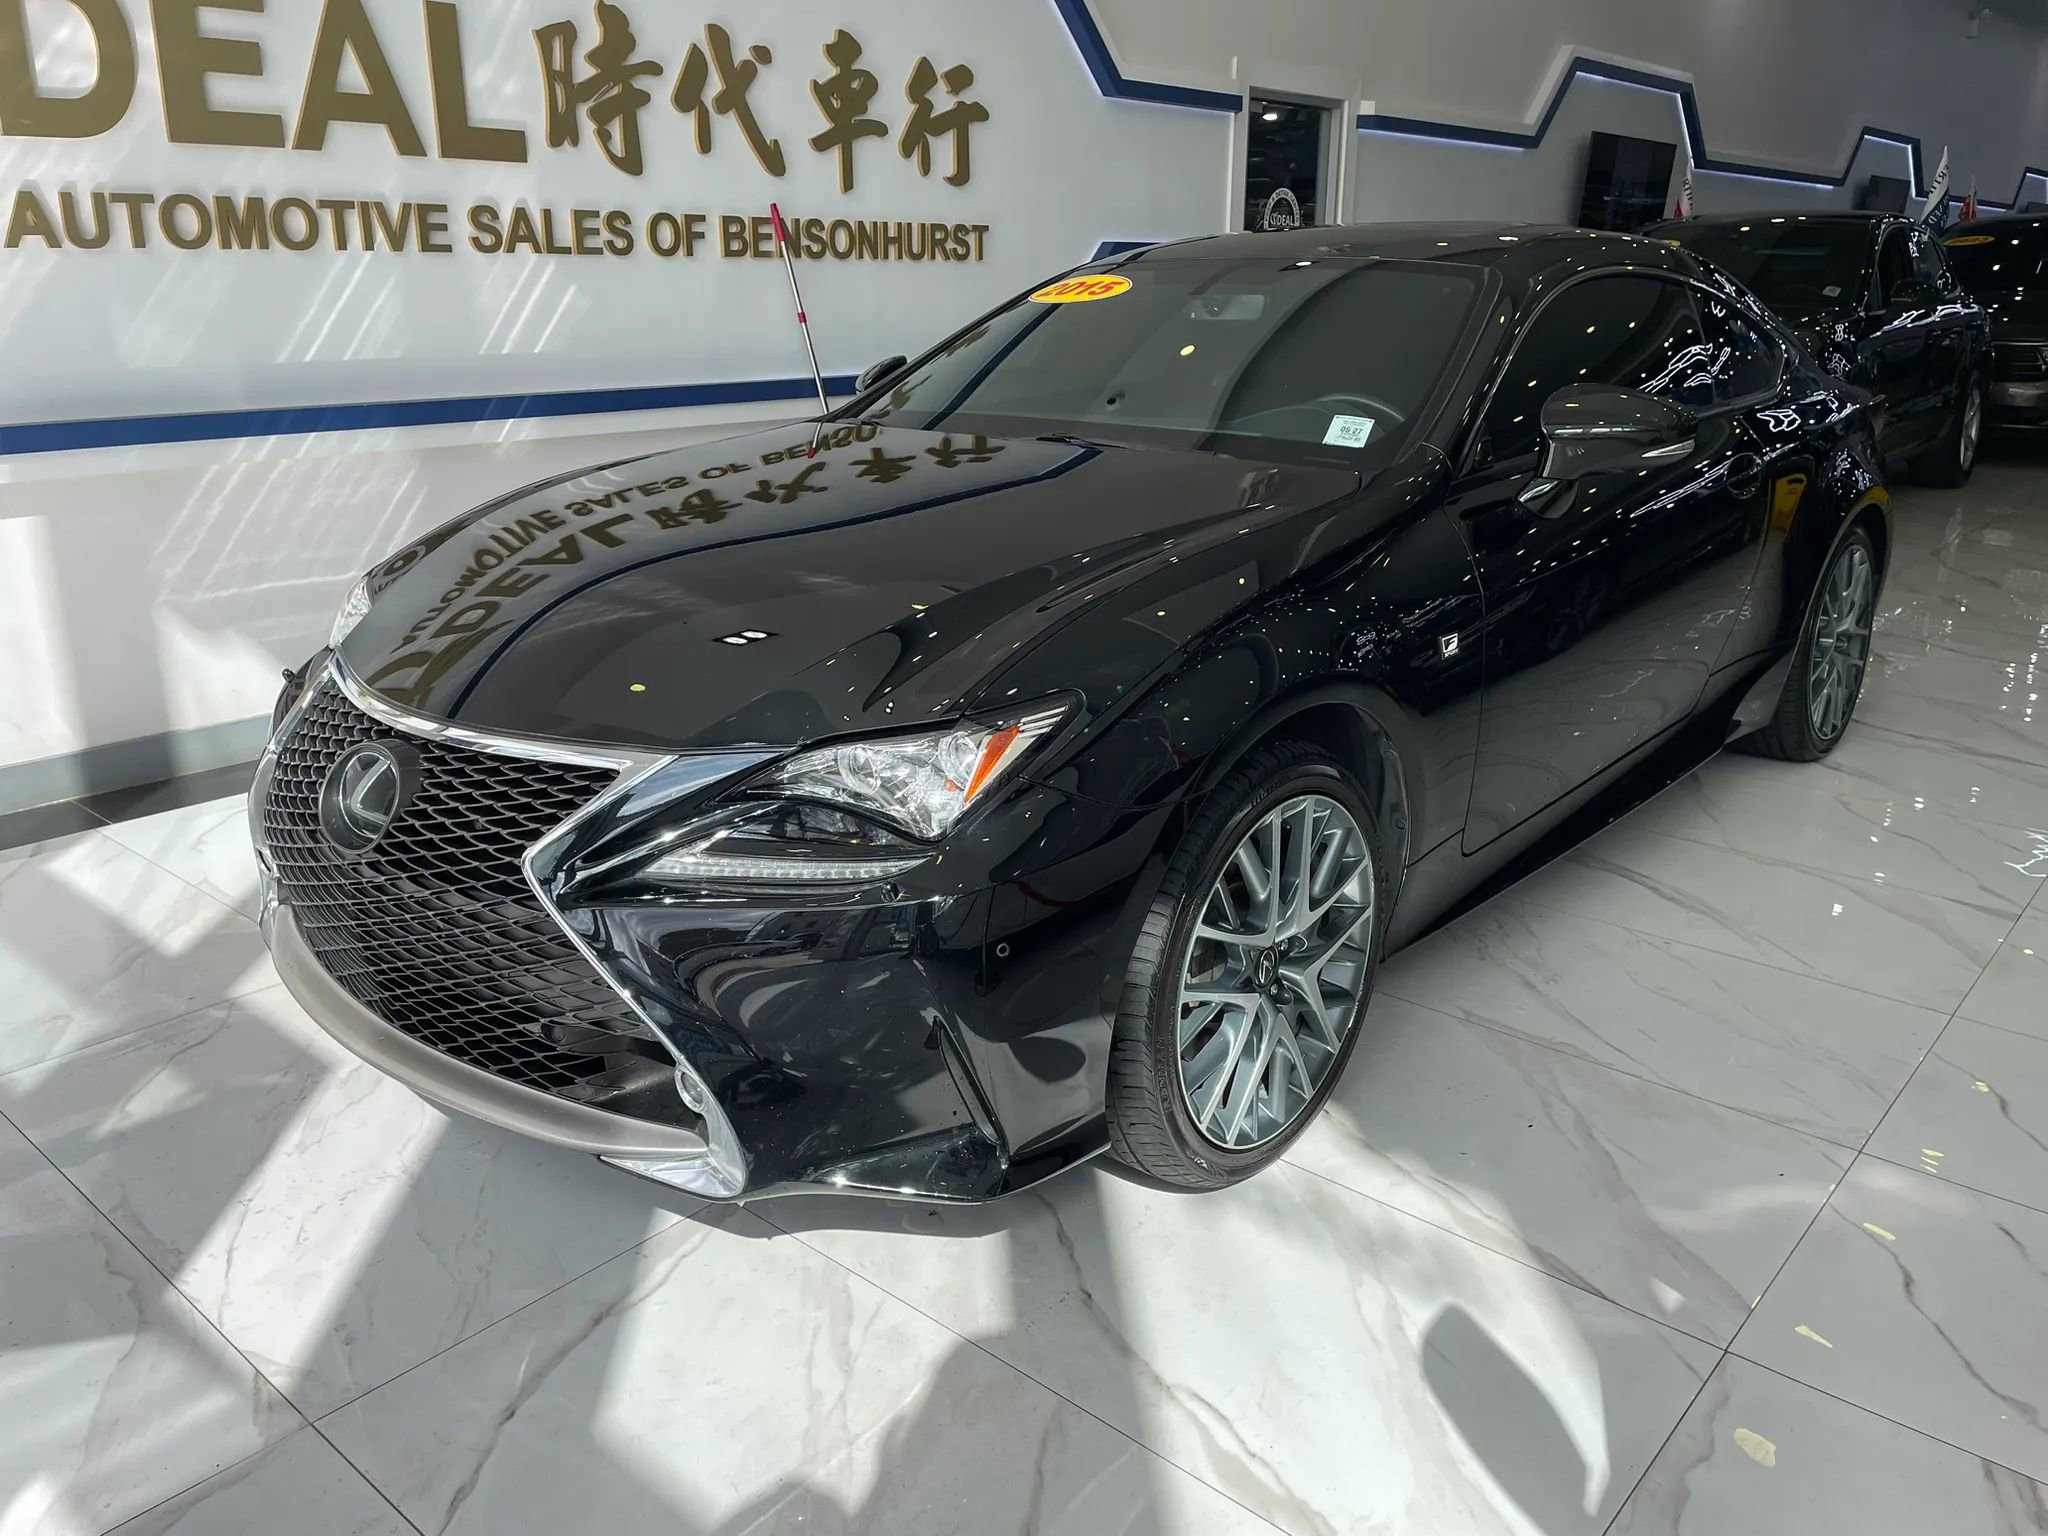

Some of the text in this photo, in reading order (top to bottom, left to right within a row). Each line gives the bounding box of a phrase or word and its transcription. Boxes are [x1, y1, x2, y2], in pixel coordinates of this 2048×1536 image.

[4, 190, 990, 263] AUTOMOTIVE SALES OF BENSONHURST
[1036, 280, 1126, 298] 2015
